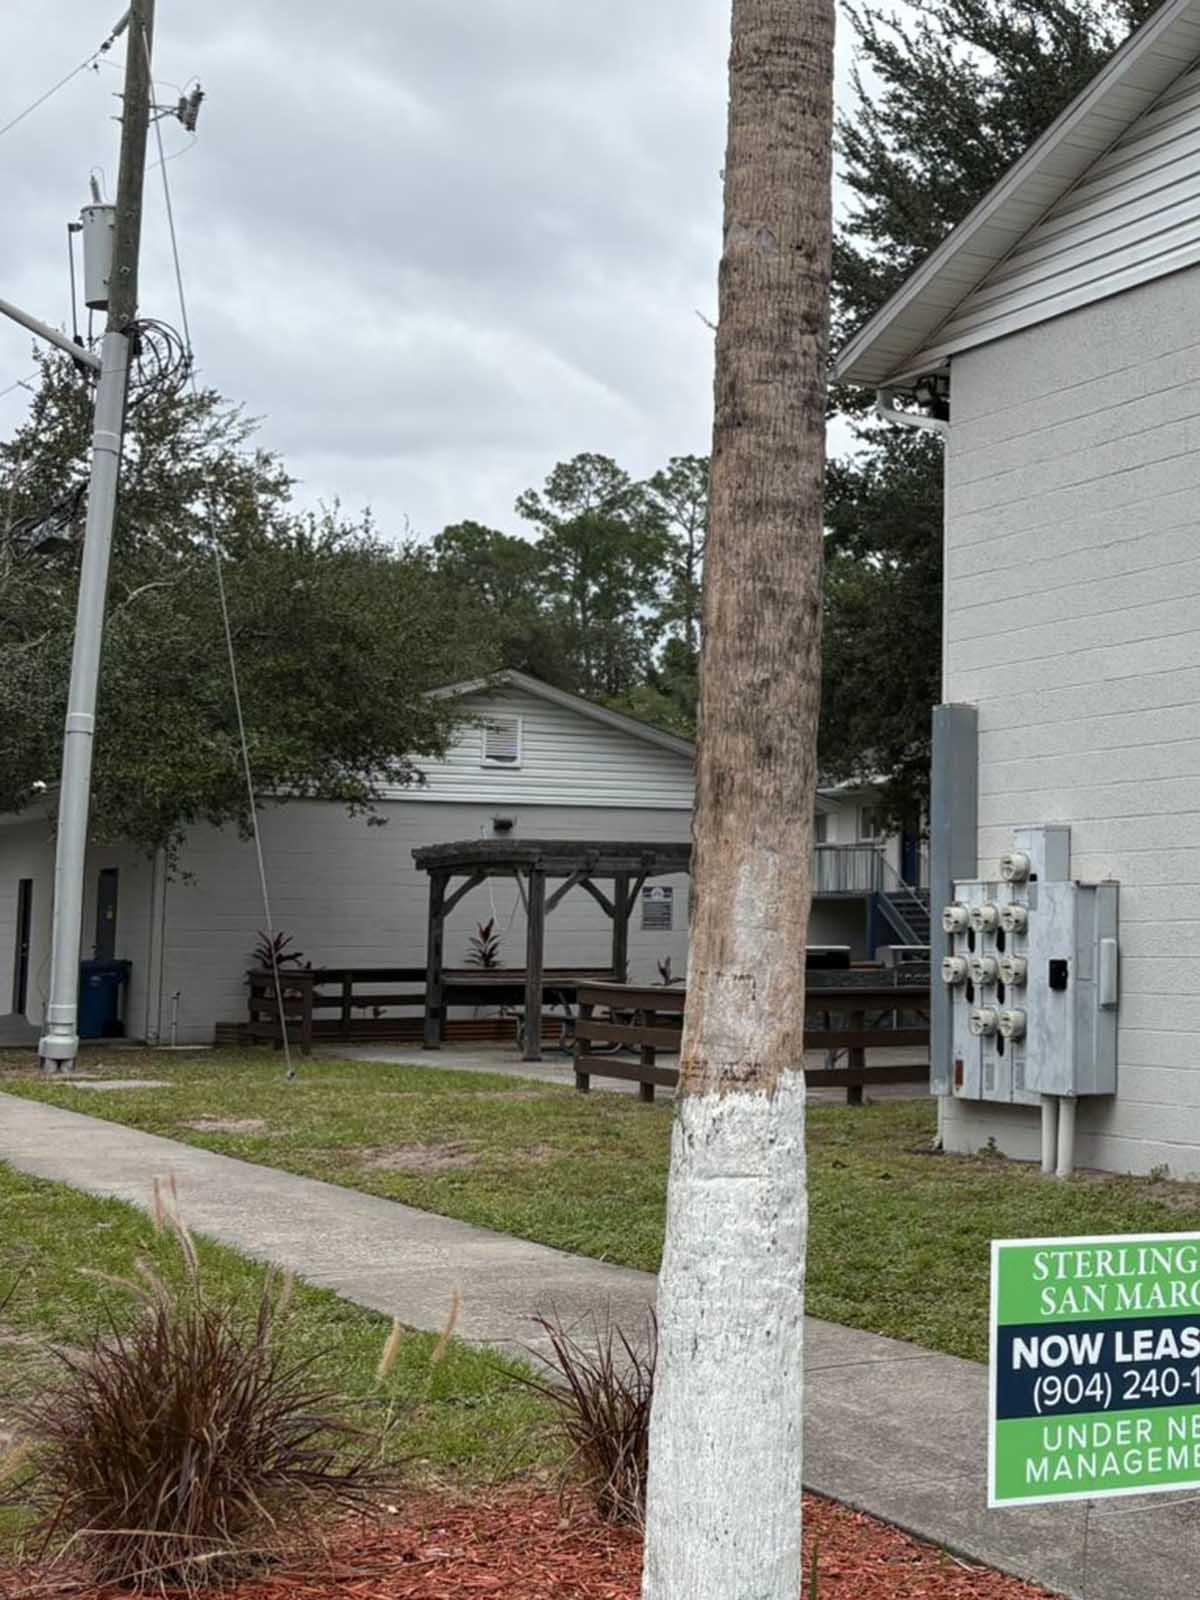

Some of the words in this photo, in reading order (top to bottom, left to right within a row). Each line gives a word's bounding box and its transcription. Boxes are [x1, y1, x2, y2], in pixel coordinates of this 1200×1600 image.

[1032, 1246, 1197, 1281] STERLING
[1040, 1284, 1105, 1316] SAN
[1012, 1332, 1104, 1370] NOW
[1033, 1372, 1112, 1414] (904)
[1043, 1418, 1152, 1452] UNDER
